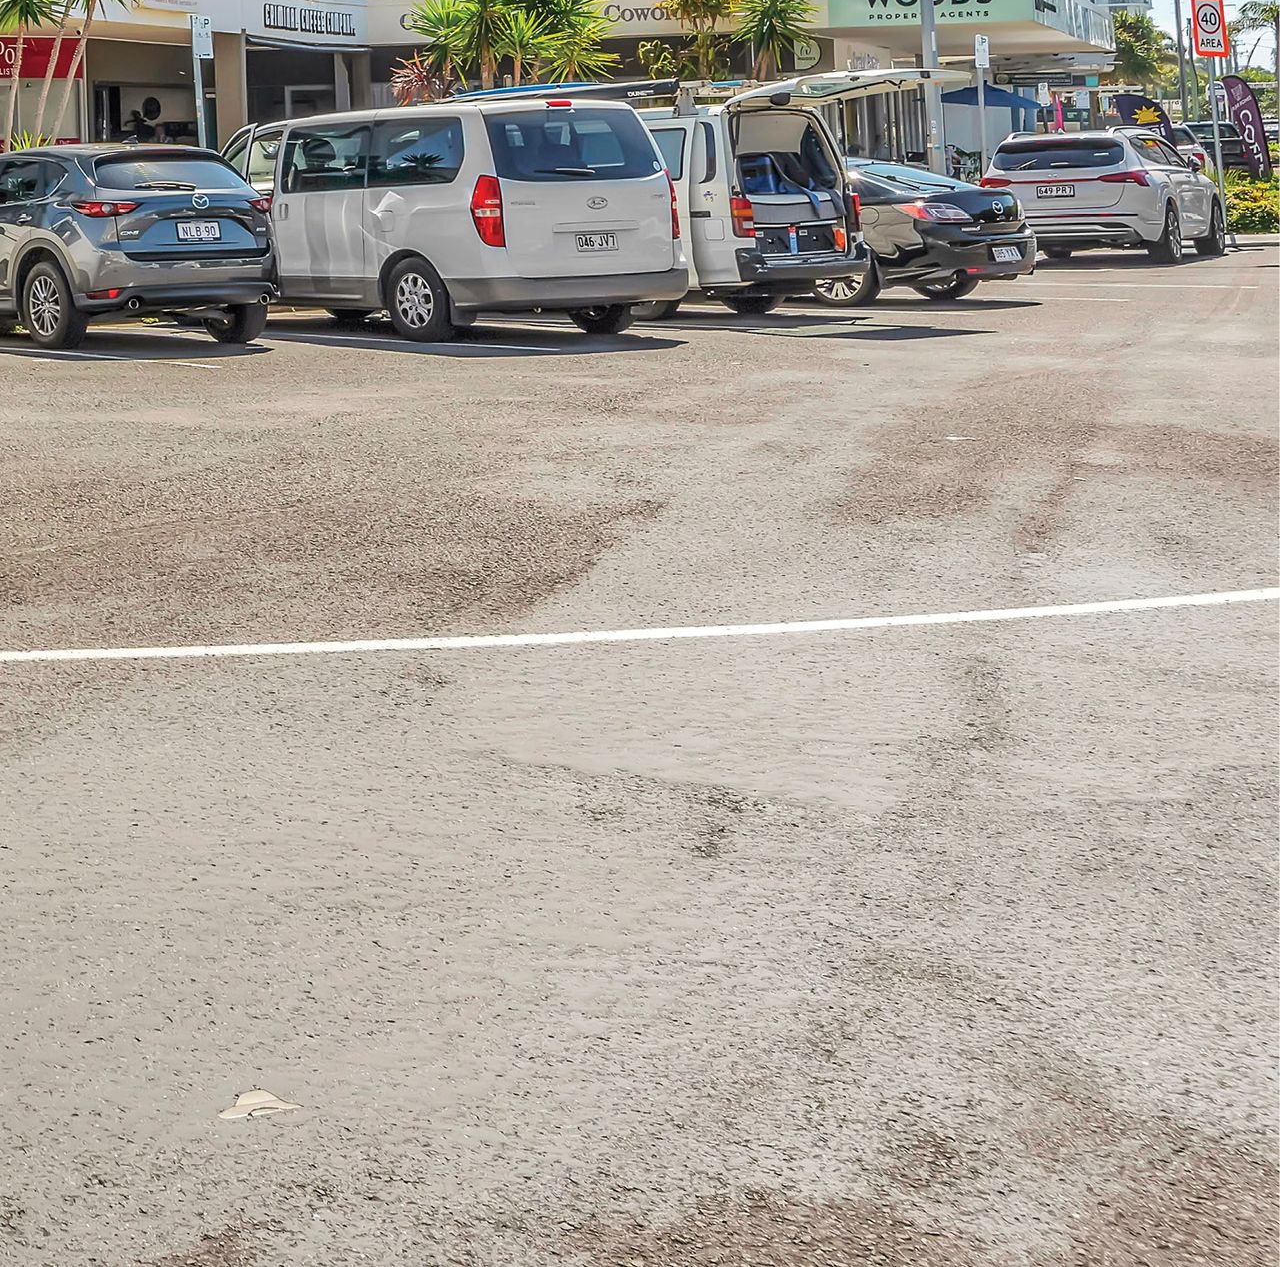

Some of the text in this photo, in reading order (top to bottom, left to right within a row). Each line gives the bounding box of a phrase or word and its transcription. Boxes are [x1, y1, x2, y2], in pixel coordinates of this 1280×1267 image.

[604, 4, 680, 23] Cowor
[940, 10, 989, 18] AGENTS
[1200, 11, 1217, 26] 40
[1200, 39, 1223, 48] AREA
